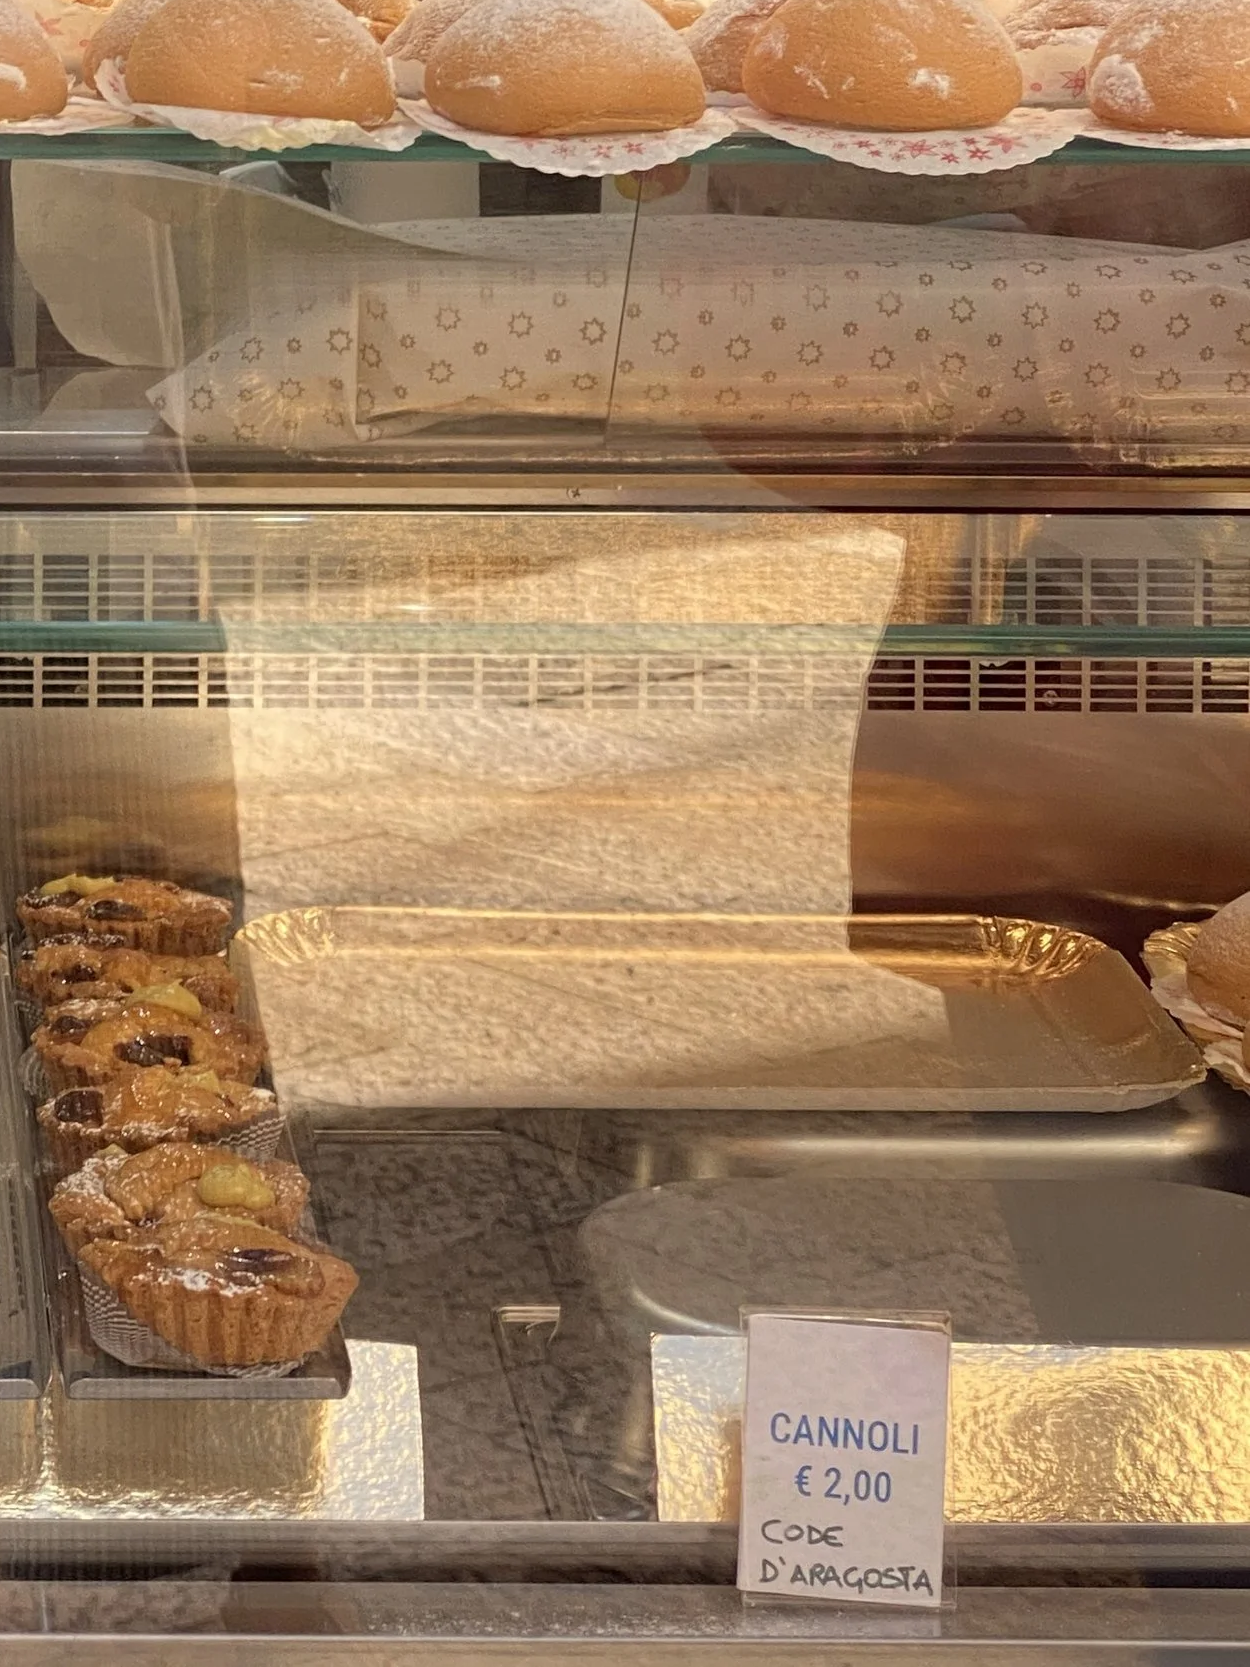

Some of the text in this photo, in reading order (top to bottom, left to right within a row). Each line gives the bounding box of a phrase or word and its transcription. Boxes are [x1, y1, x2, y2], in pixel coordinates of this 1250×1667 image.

[770, 1412, 919, 1455] CANNOLI
[795, 1465, 892, 1506] € 2,00
[761, 1519, 844, 1547] CODE
